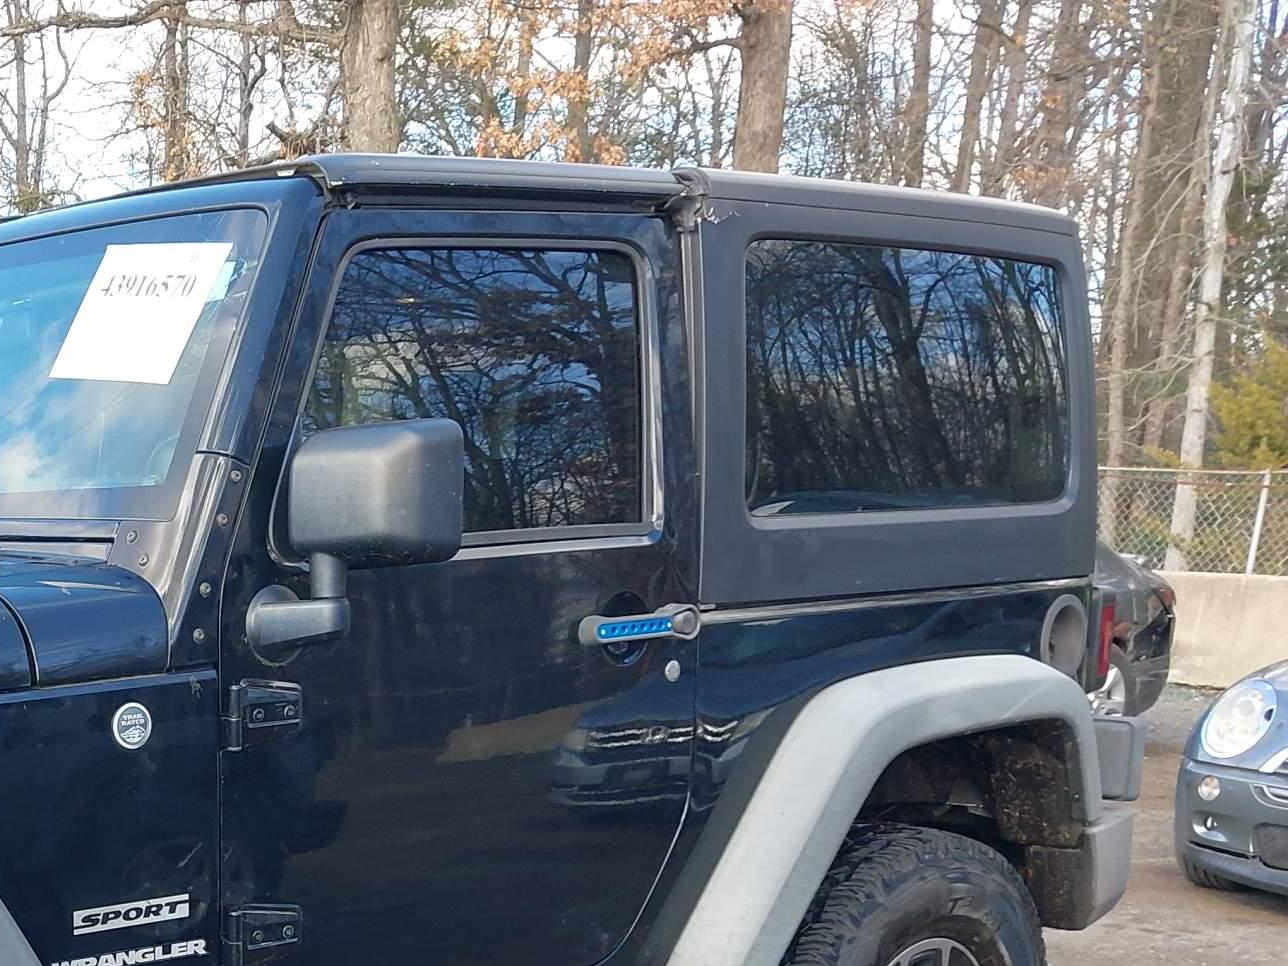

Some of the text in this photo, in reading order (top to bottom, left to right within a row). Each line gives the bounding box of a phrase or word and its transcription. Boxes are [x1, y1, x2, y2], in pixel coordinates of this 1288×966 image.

[101, 274, 197, 297] 43916570
[121, 718, 145, 726] RATED
[81, 901, 182, 927] SPORT
